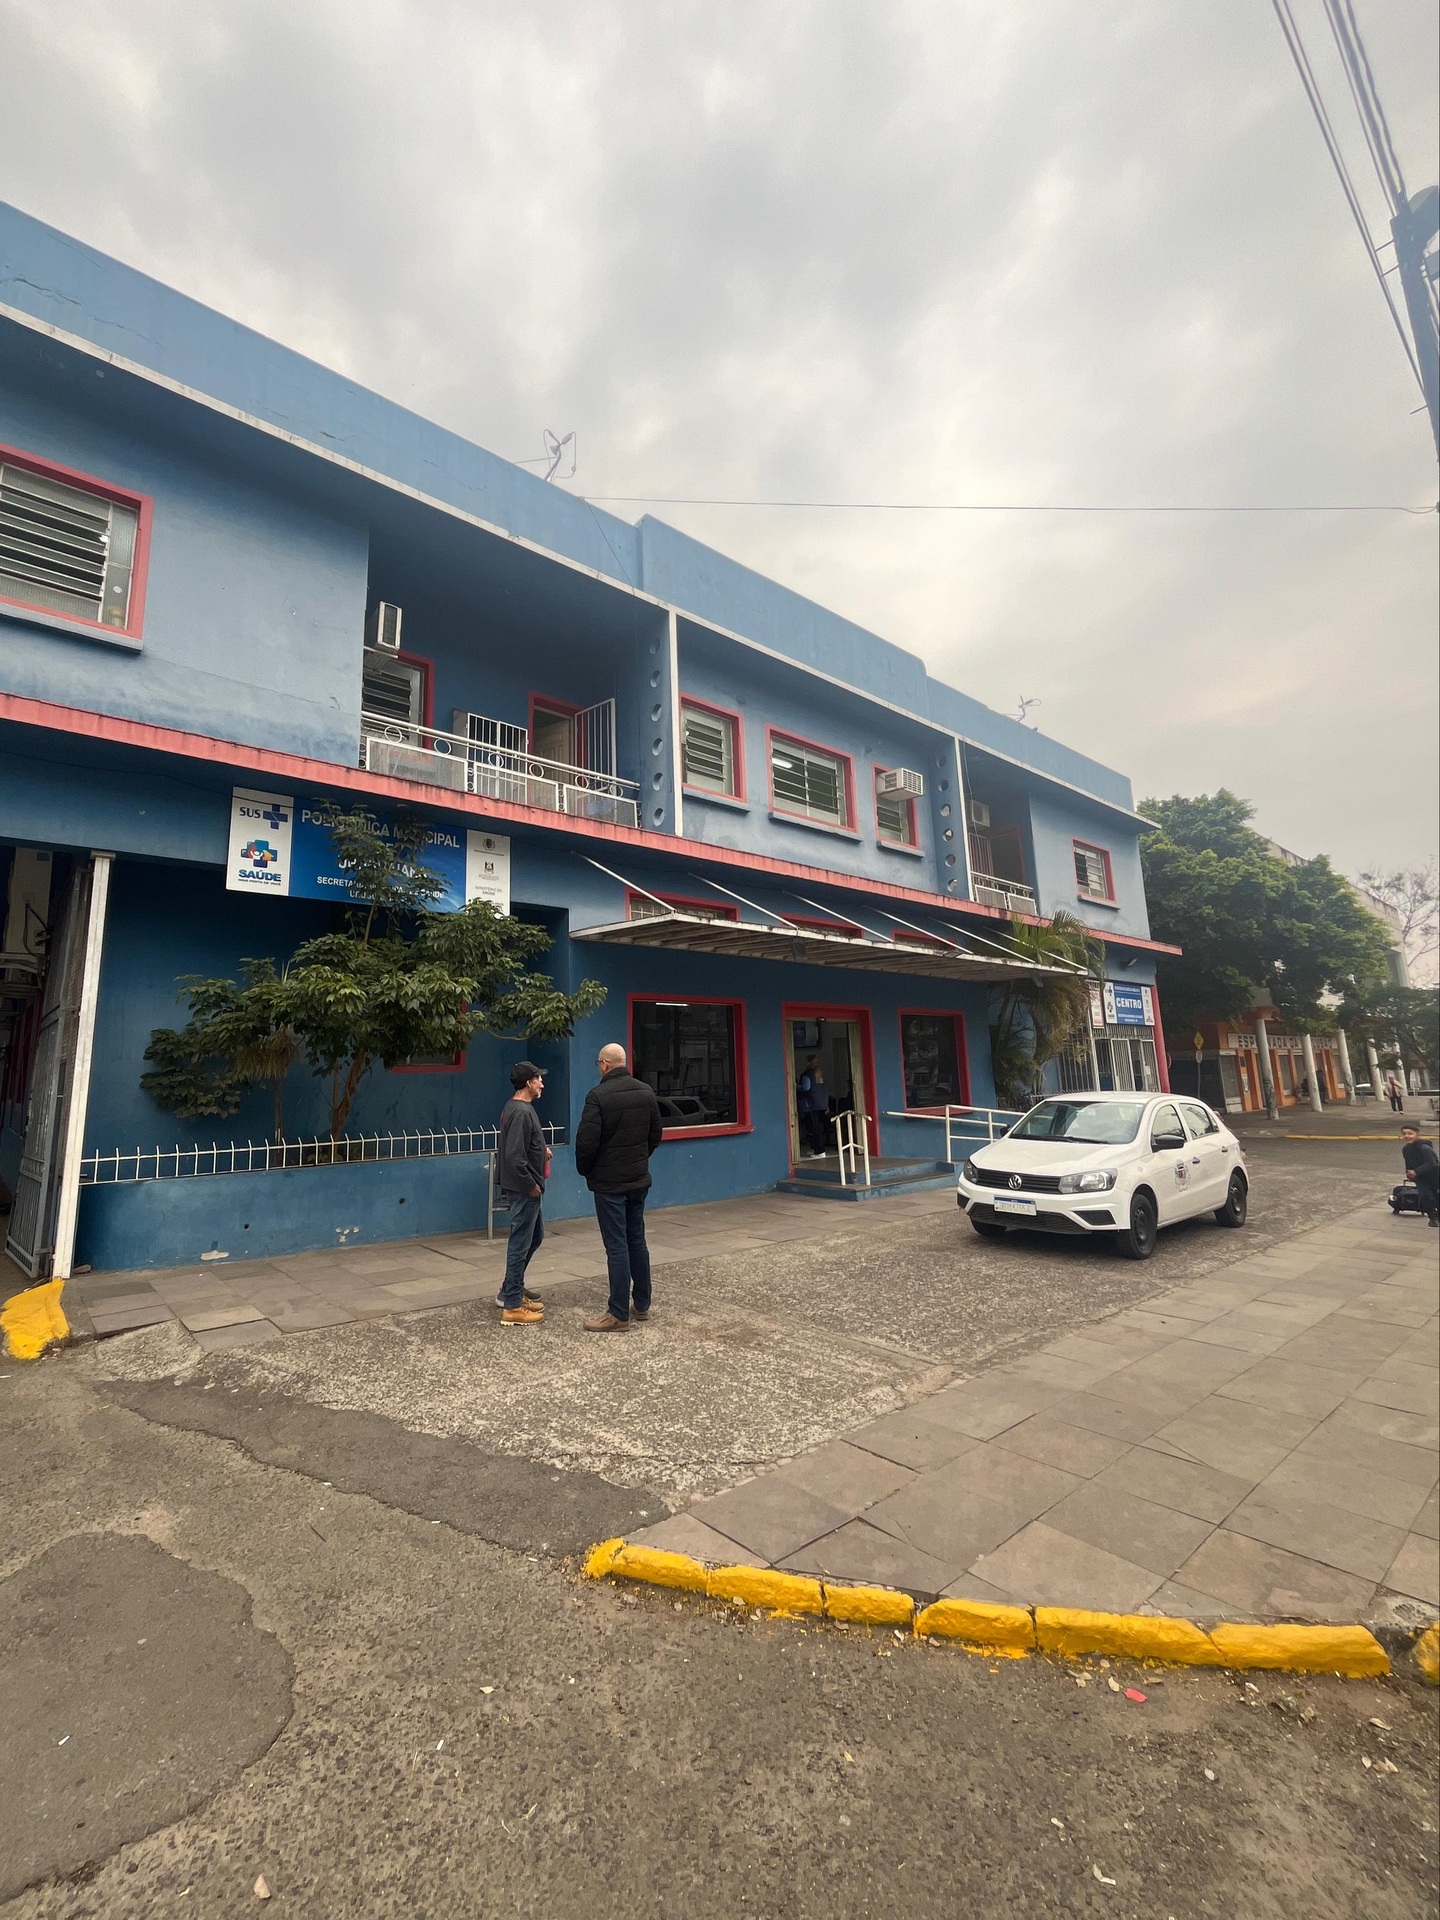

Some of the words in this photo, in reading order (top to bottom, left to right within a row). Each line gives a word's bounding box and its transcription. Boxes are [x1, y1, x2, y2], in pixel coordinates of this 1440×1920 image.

[239, 806, 261, 819] SUS
[301, 809, 391, 837] POLICICA
[393, 825, 461, 848] MCIPAL
[238, 869, 281, 882] SAÚDE
[1115, 997, 1142, 1010] CENTRO
